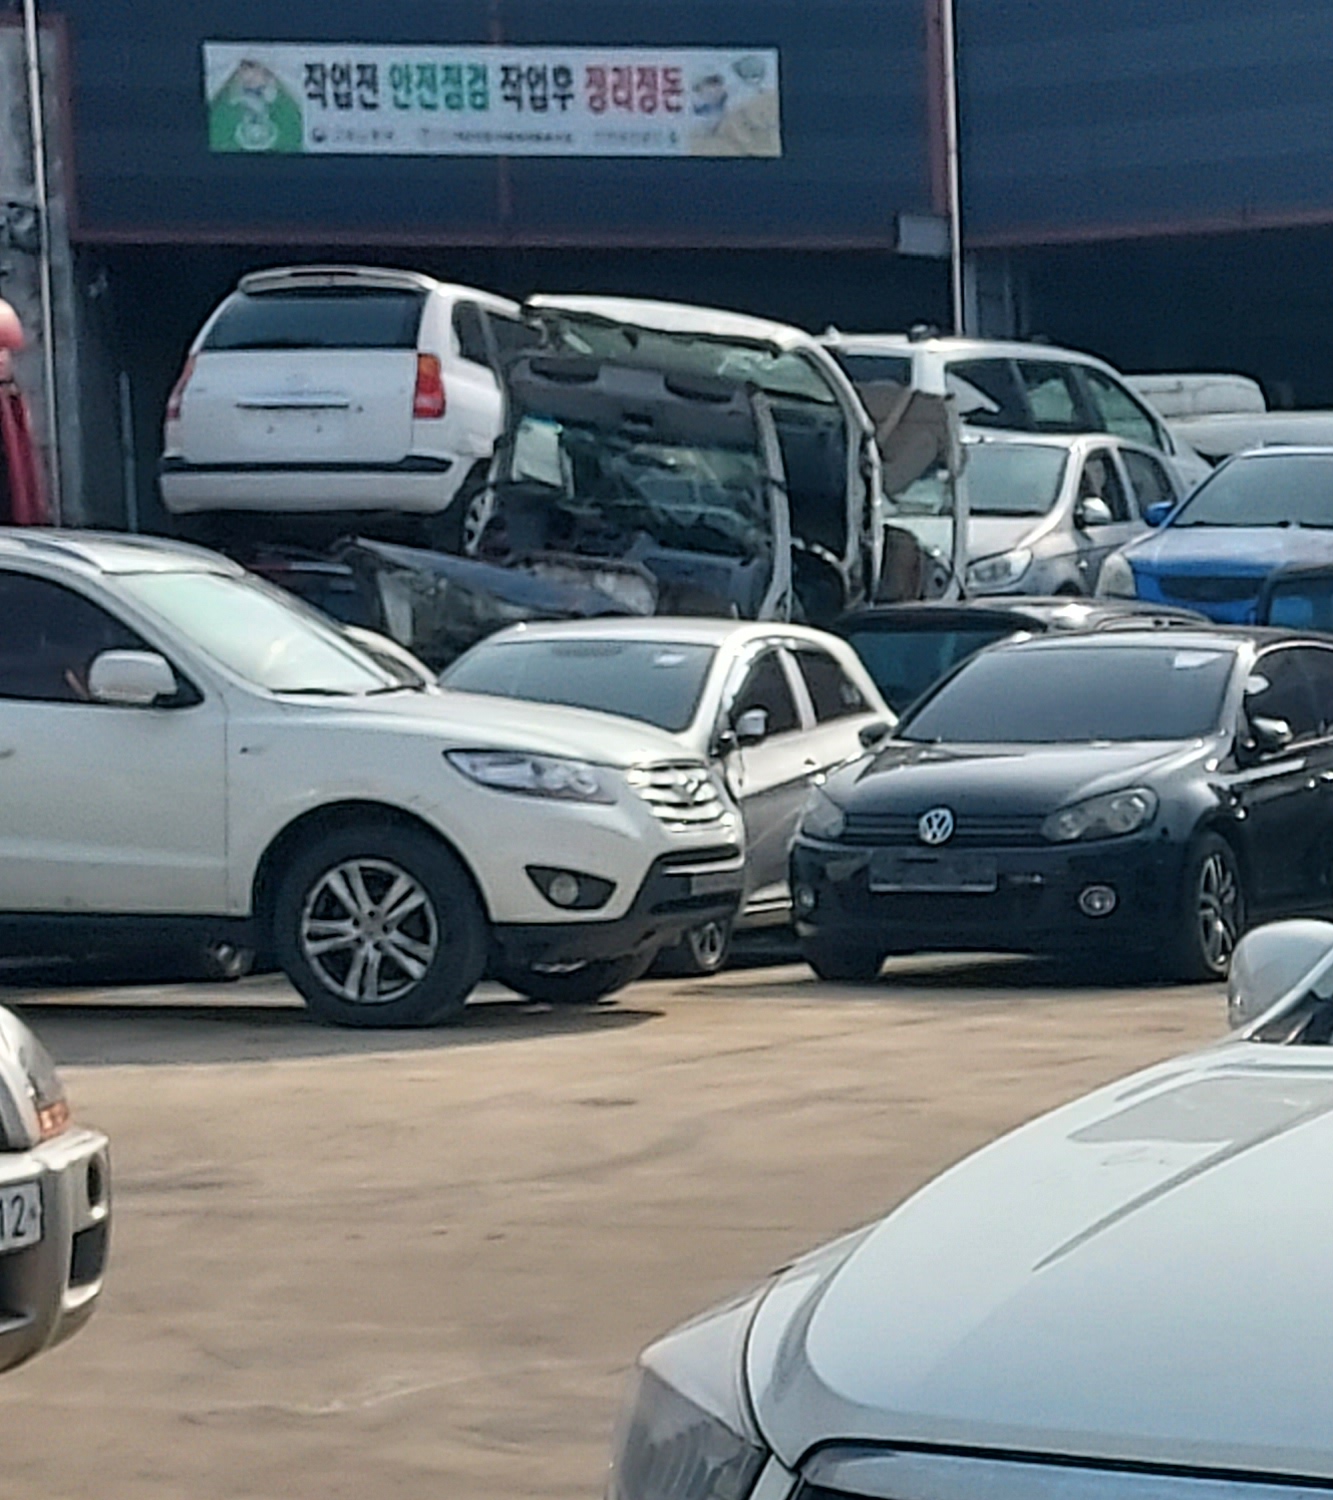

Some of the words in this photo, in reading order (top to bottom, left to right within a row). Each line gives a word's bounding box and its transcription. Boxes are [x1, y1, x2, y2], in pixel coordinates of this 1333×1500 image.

[304, 63, 379, 110] 작업전
[389, 63, 490, 111] 안전점검
[500, 65, 575, 113] 작업후
[585, 66, 684, 114] 정리정돈
